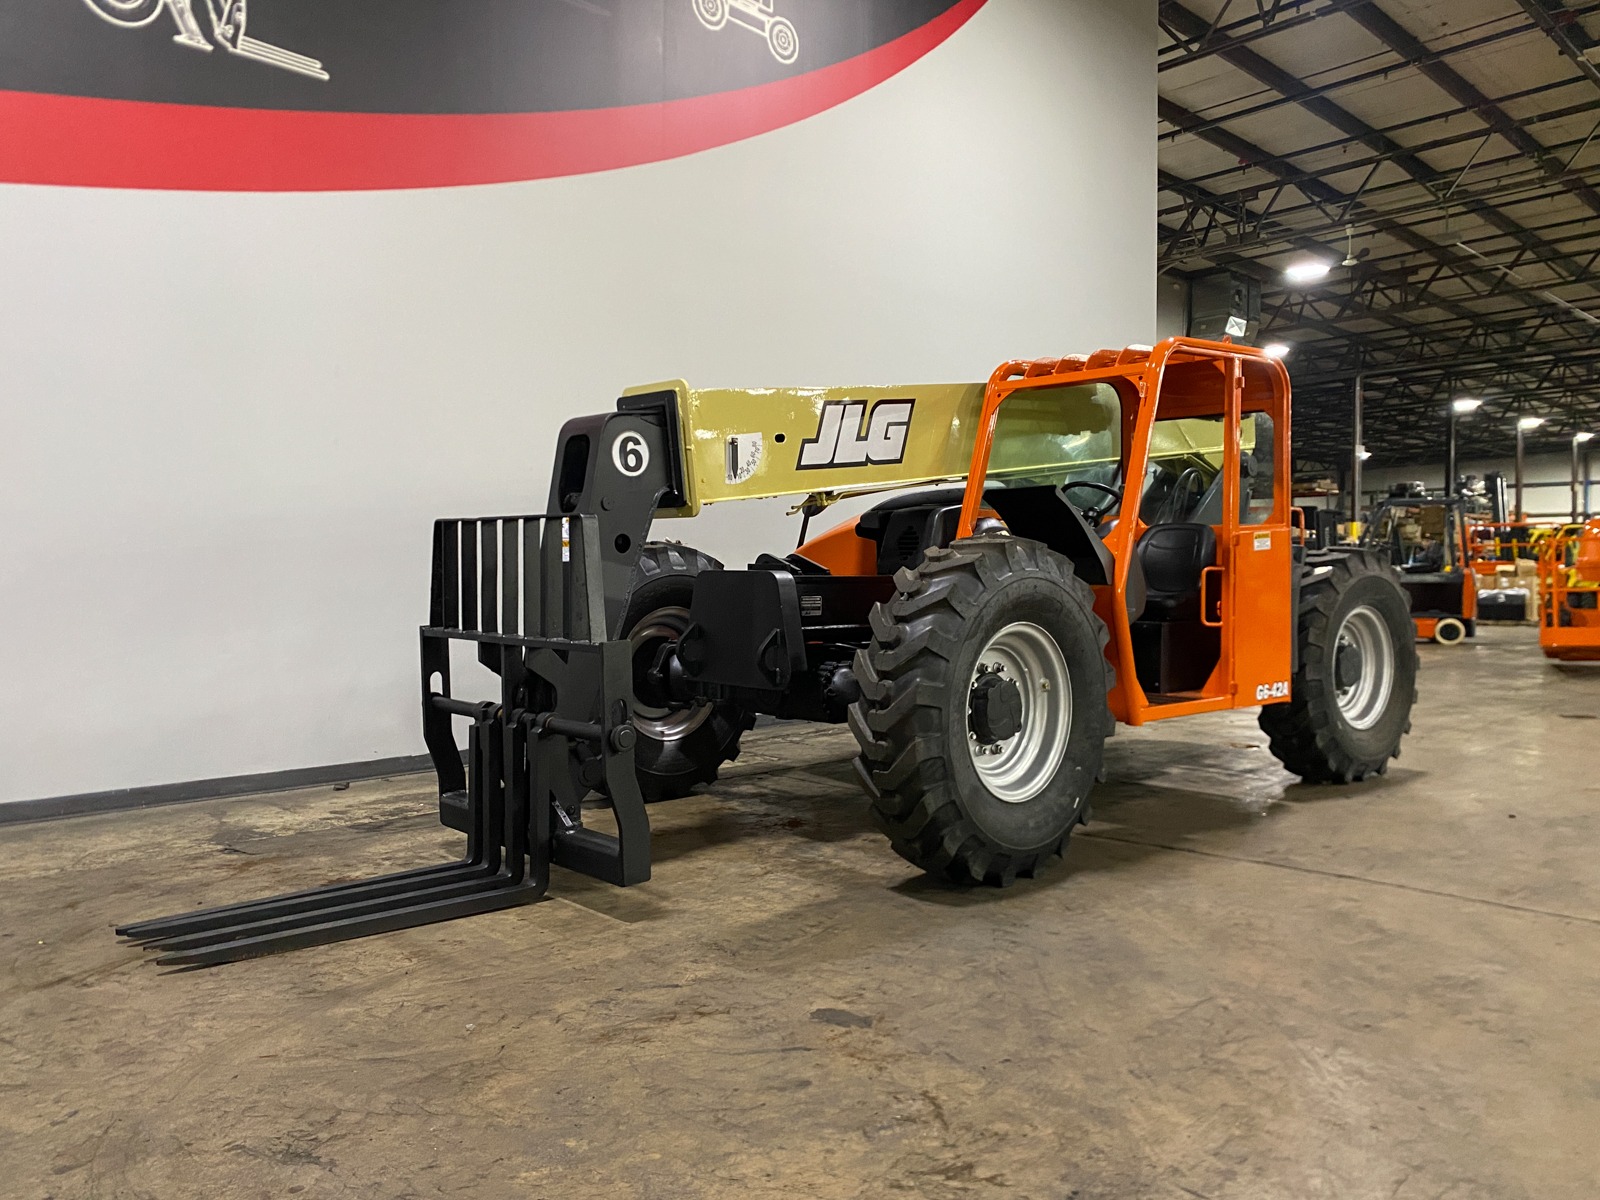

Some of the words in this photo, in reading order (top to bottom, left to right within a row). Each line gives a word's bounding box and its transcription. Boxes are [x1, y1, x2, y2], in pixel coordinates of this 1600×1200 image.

[796, 399, 916, 470] JLG
[619, 435, 644, 472] 6
[1256, 681, 1289, 700] G6-42A
